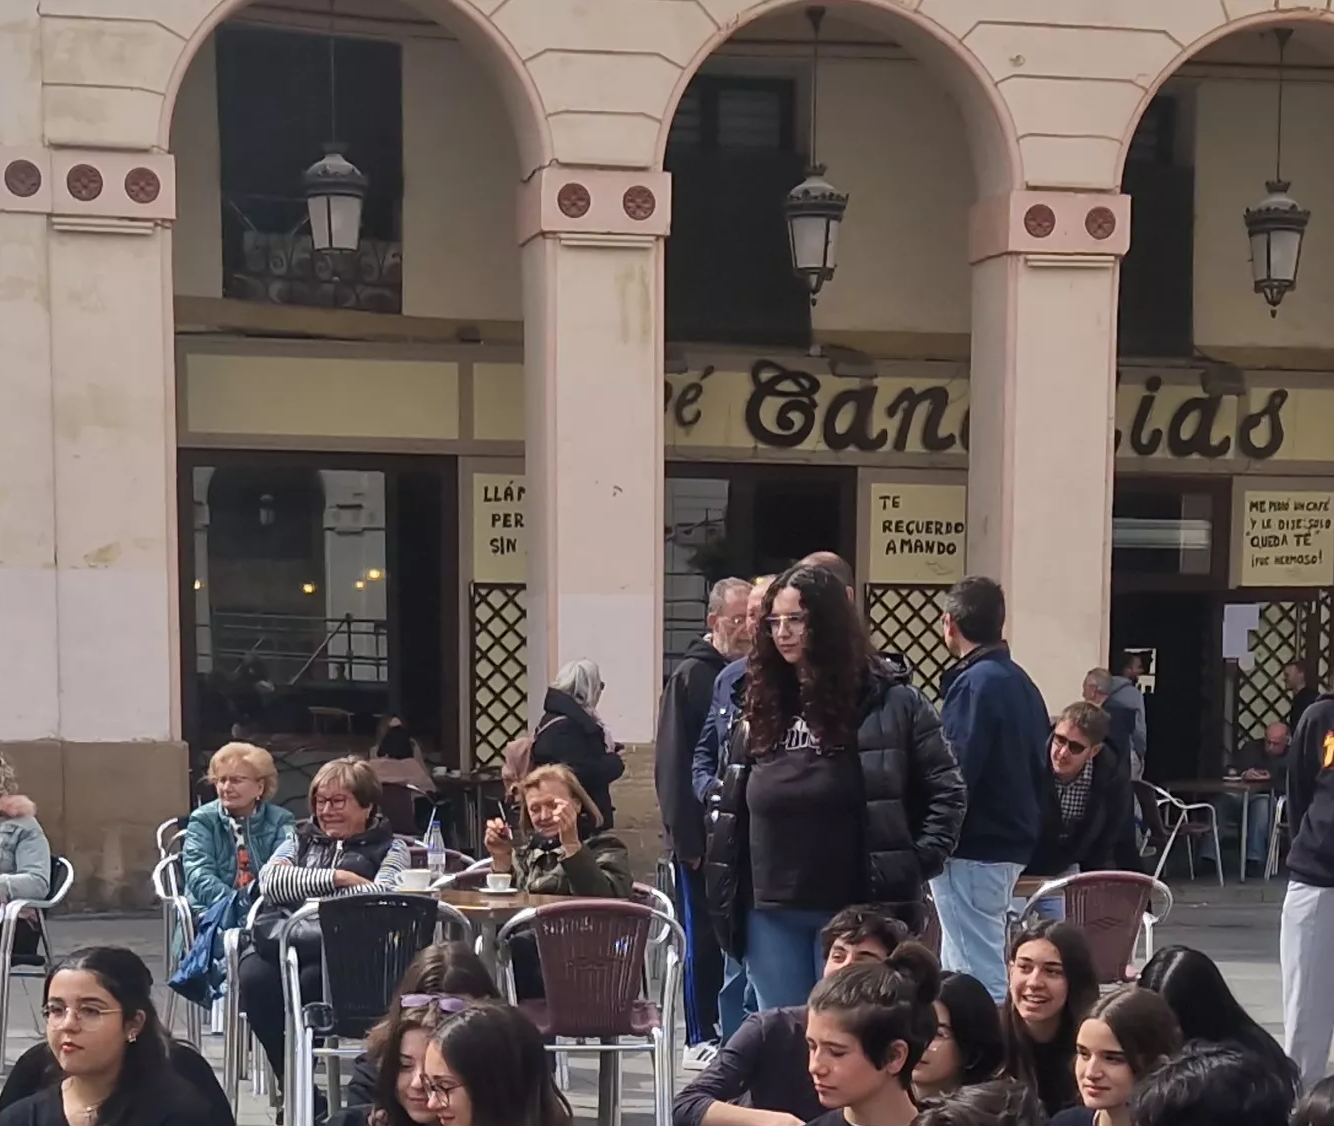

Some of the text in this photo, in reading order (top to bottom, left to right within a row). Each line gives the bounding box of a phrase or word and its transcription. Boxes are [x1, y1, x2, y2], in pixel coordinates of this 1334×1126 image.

[879, 496, 900, 511] TE
[1249, 501, 1266, 513] ME
[882, 519, 964, 536] RECUERDO
[1250, 518, 1257, 530] Y
[1262, 518, 1272, 530] LE
[489, 536, 517, 555] SIN
